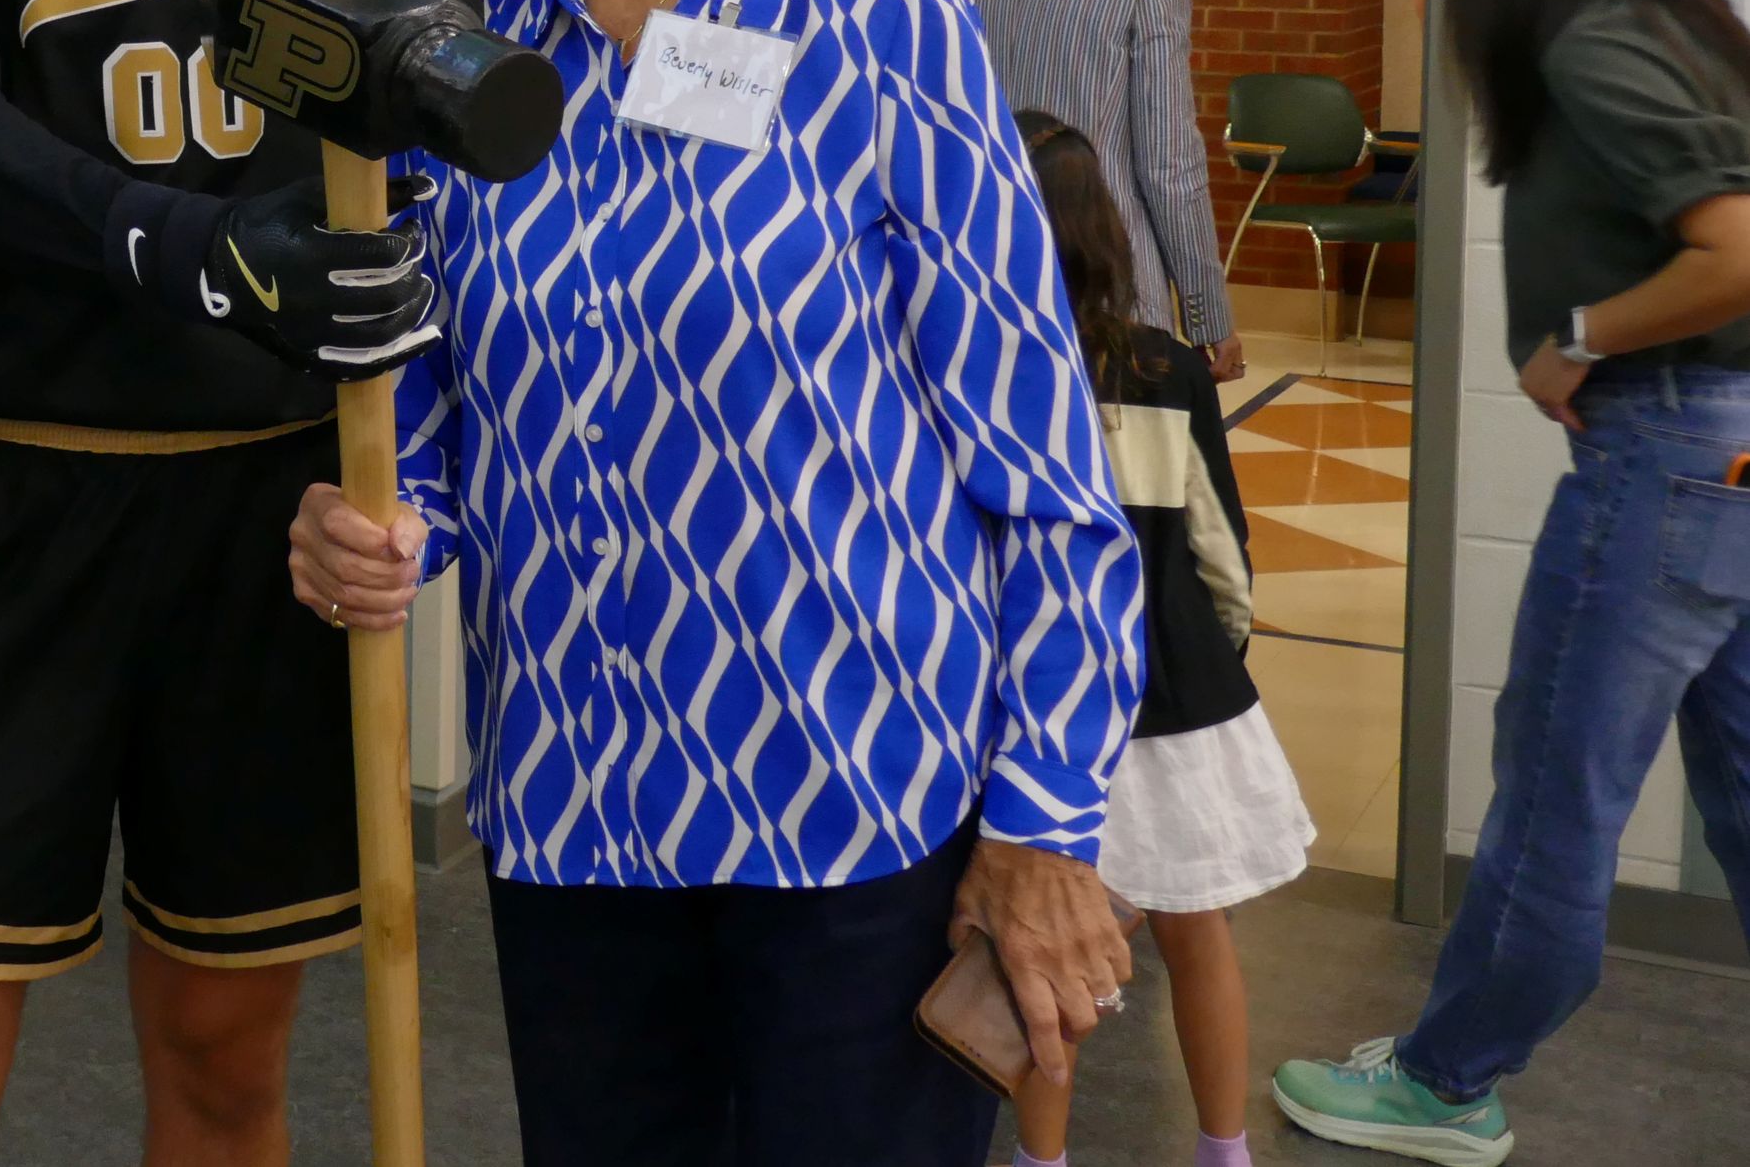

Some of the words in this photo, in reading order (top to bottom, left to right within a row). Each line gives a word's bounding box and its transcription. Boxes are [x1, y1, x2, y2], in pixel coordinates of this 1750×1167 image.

[102, 41, 266, 165] 00
[658, 46, 714, 89] Beverly
[719, 69, 775, 97] Wisler
